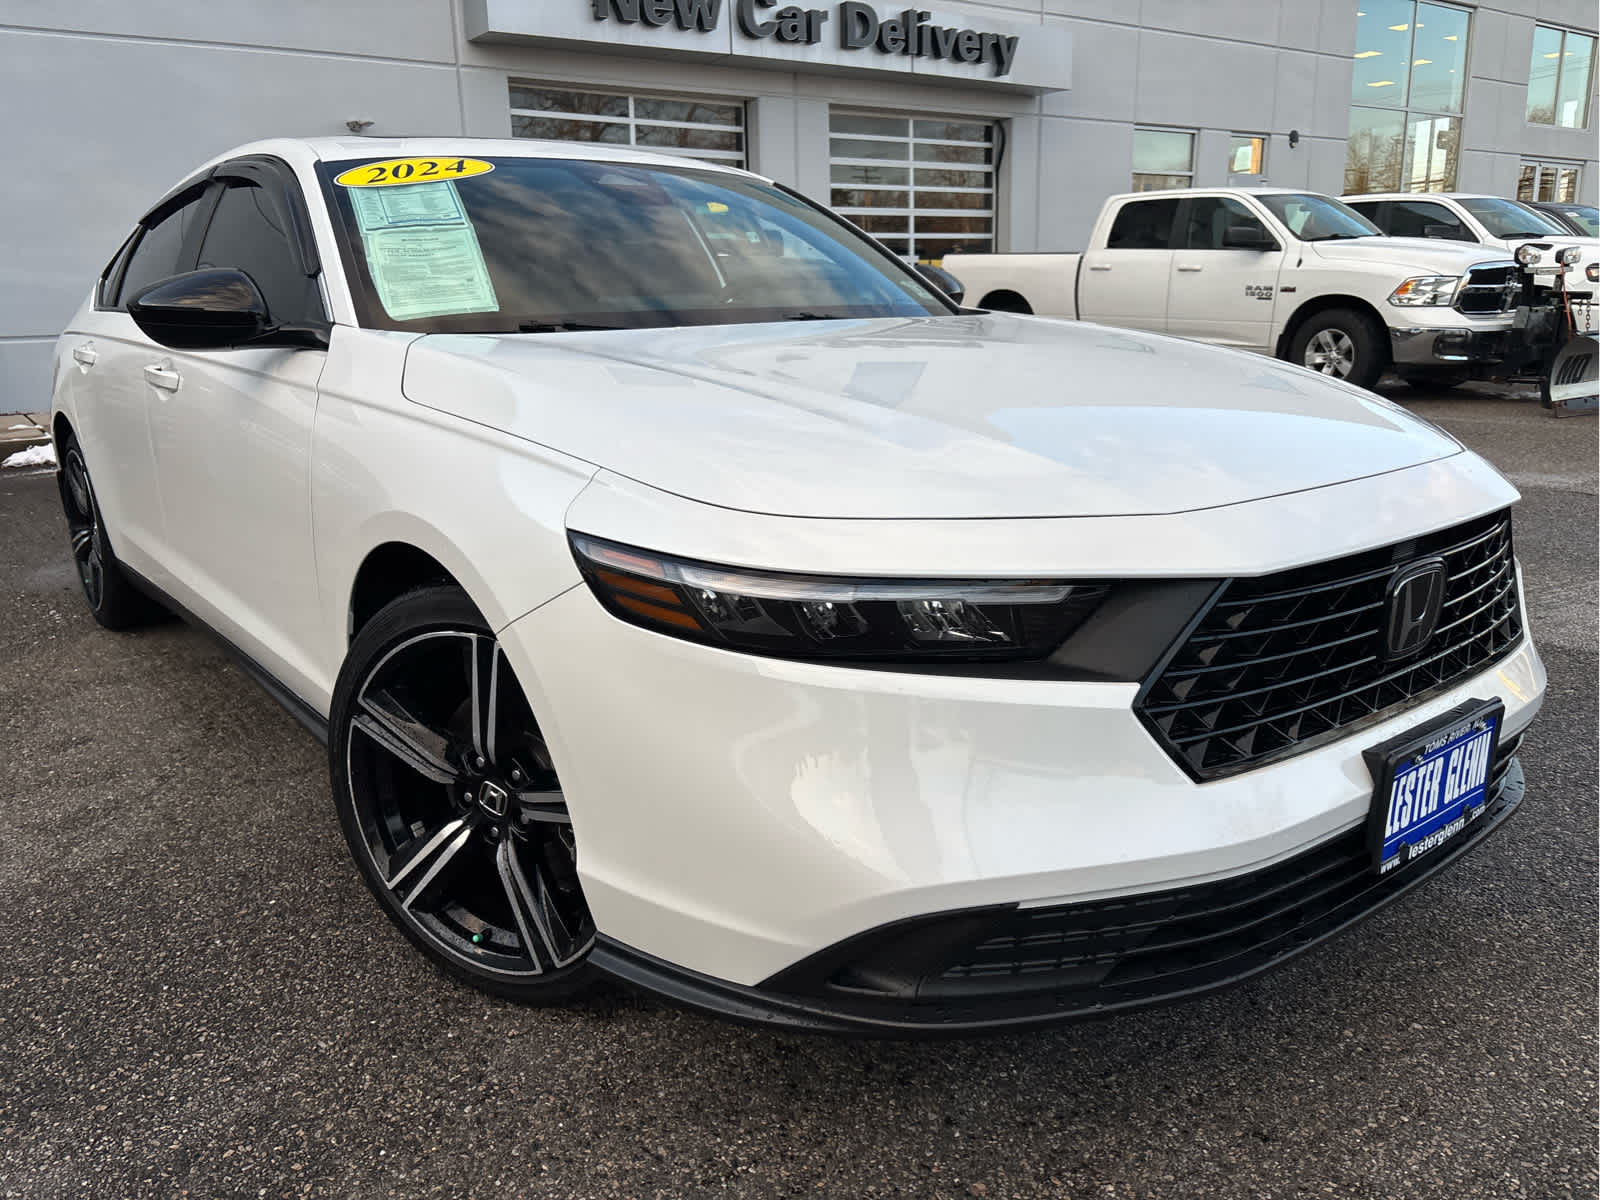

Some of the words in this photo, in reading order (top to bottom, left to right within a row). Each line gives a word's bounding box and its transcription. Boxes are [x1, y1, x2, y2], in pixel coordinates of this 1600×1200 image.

[737, 0, 829, 43] Car
[840, 1, 1019, 76] Delivery
[367, 160, 466, 183] 2024
[1424, 735, 1448, 755] TOMS
[1384, 756, 1444, 839] LESTER
[1444, 731, 1492, 804] GLENN
[1408, 818, 1465, 860] lesterglenn
